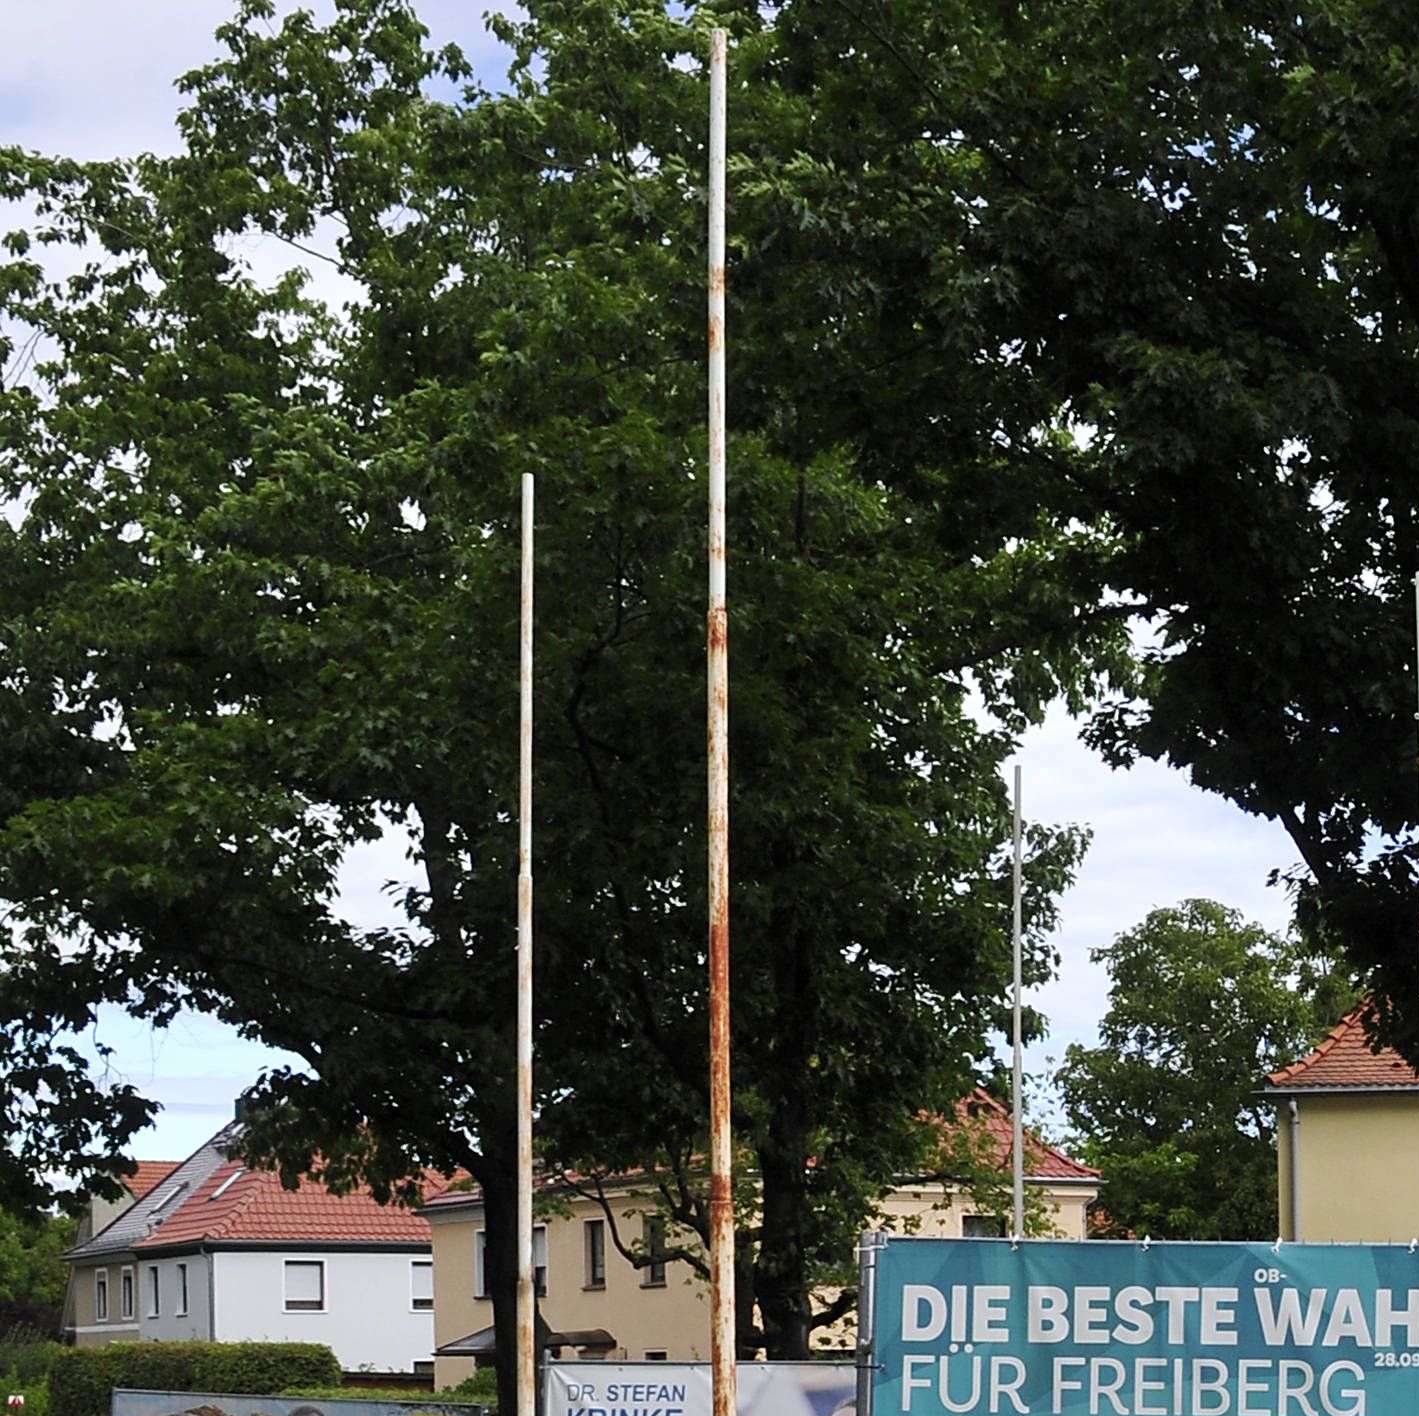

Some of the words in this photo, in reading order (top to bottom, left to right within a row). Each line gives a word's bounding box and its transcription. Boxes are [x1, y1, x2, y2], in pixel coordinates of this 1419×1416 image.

[1254, 1269, 1286, 1282] OB-
[902, 1284, 1010, 1342] DIE
[1028, 1286, 1238, 1346] BESTE
[568, 1384, 600, 1402] DR.
[606, 1384, 686, 1402] STEFAN
[902, 1343, 1030, 1414] FÜR
